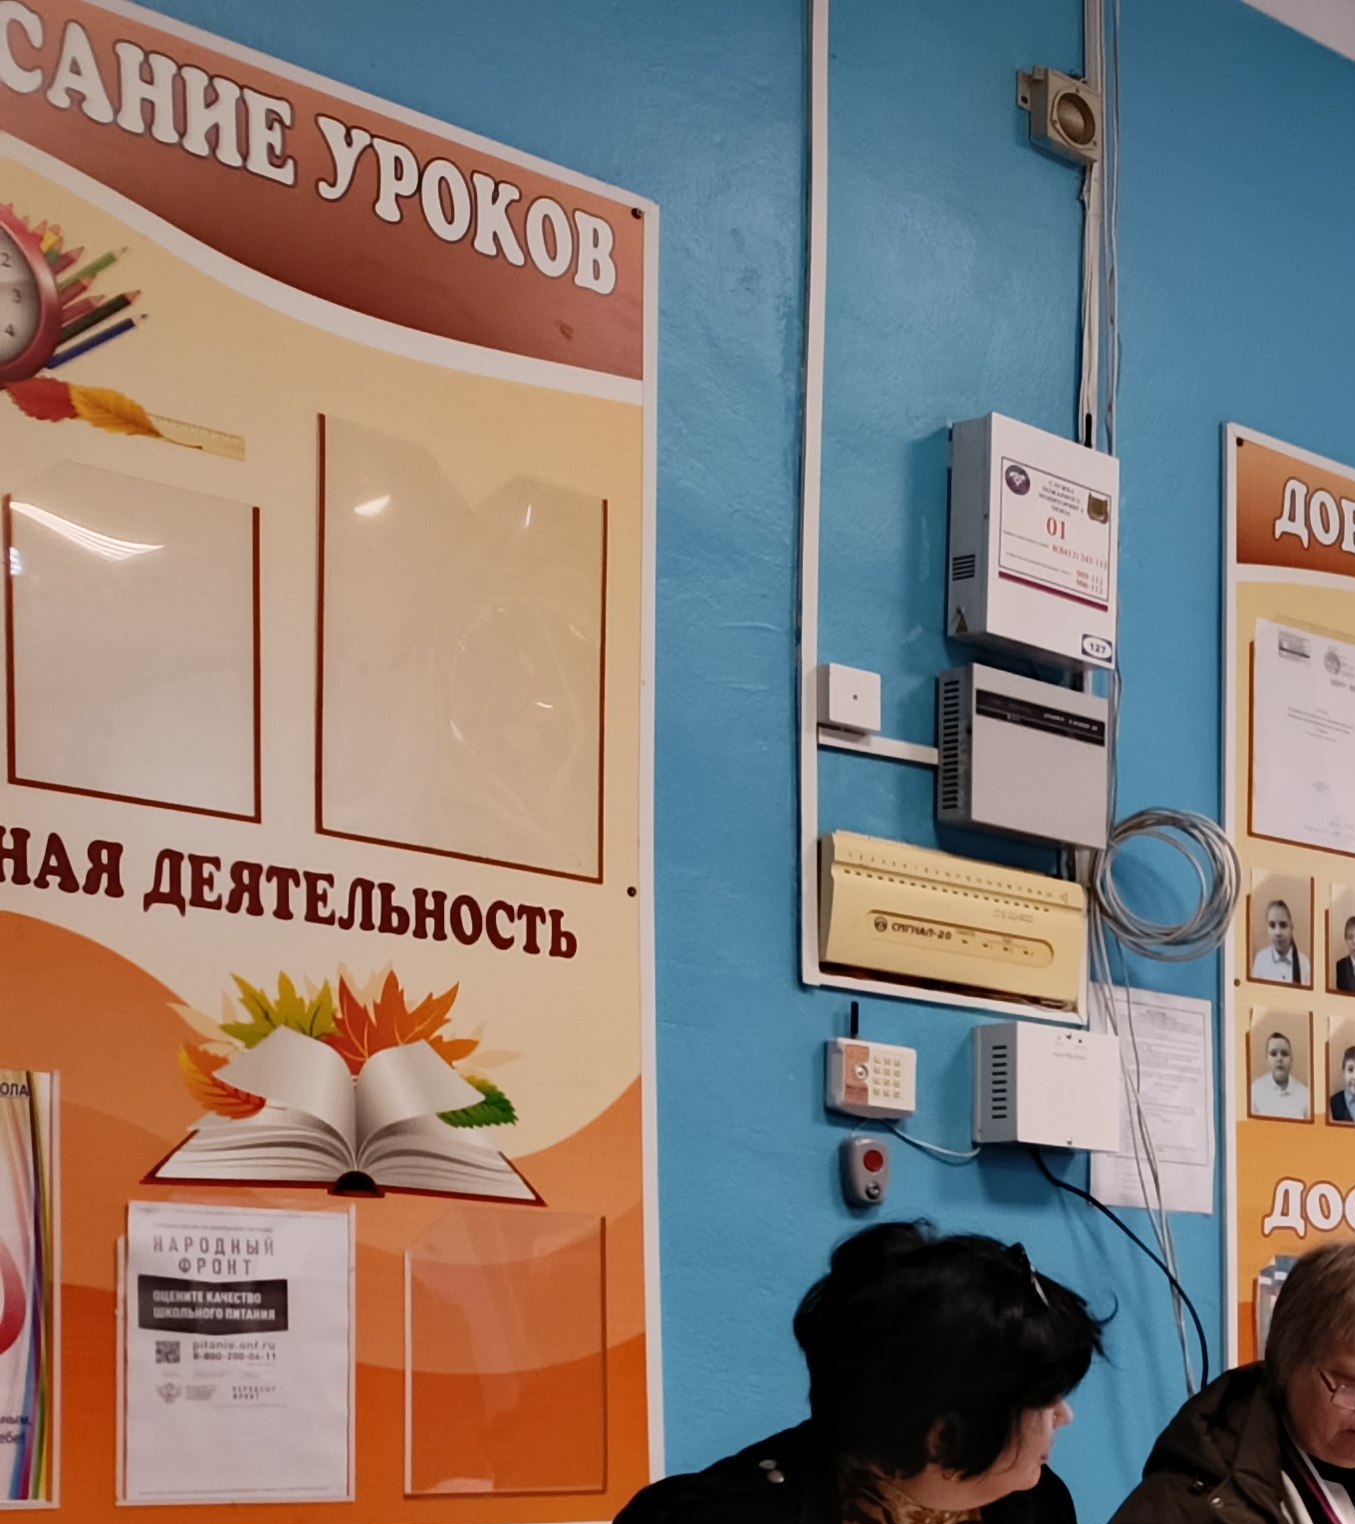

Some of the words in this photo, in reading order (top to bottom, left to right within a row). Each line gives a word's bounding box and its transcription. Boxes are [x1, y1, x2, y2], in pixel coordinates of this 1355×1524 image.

[0, 2, 296, 187] САНИЕ
[314, 113, 617, 296] УРОКОВ
[1046, 516, 1066, 540] 01
[1090, 642, 1107, 655] 127
[0, 825, 125, 898] НАЯ
[143, 848, 579, 959] ДЕЯТЕЛЬНОСТЬ
[153, 1235, 275, 1256] НАРОДНЫЙ
[178, 1257, 252, 1276] ФРОНТ
[152, 1289, 204, 1304] ОЦЕНИТЕ
[206, 1291, 262, 1305] КАЧЕСТВО
[153, 1306, 223, 1319] ШКОЛЬНОГО
[225, 1308, 276, 1321] ПИТАНИЯ
